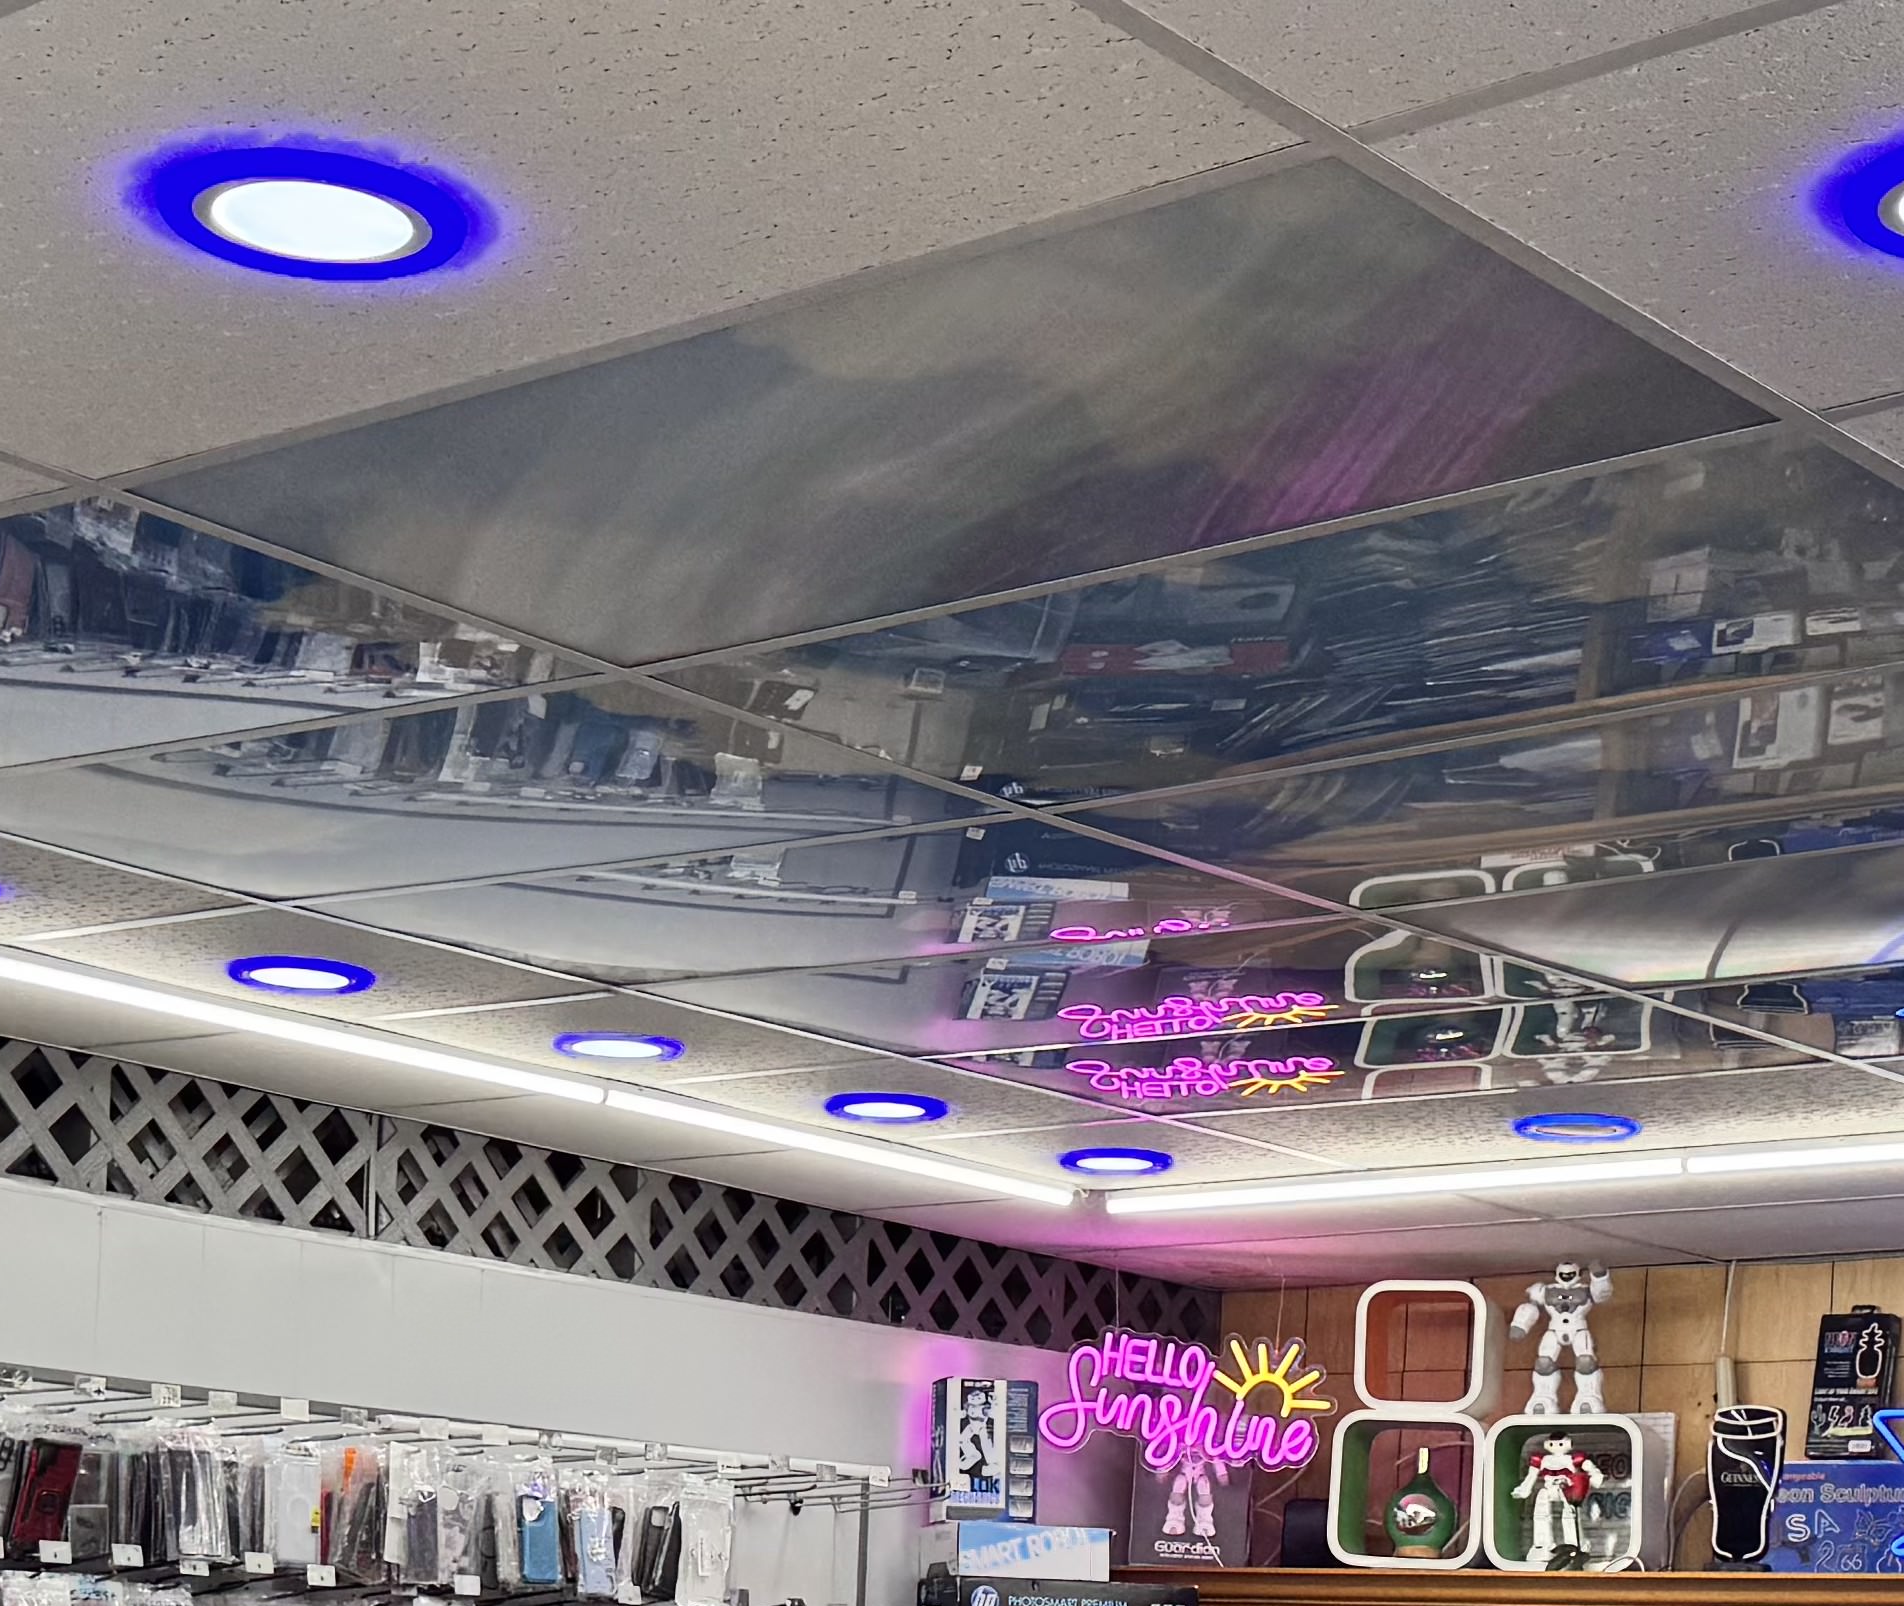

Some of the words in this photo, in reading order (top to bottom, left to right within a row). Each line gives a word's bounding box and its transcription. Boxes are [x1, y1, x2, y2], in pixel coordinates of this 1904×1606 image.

[1099, 1331, 1208, 1389] HELLO
[1038, 1346, 1316, 1468] Sunshine
[1154, 1540, 1220, 1556] Guardian
